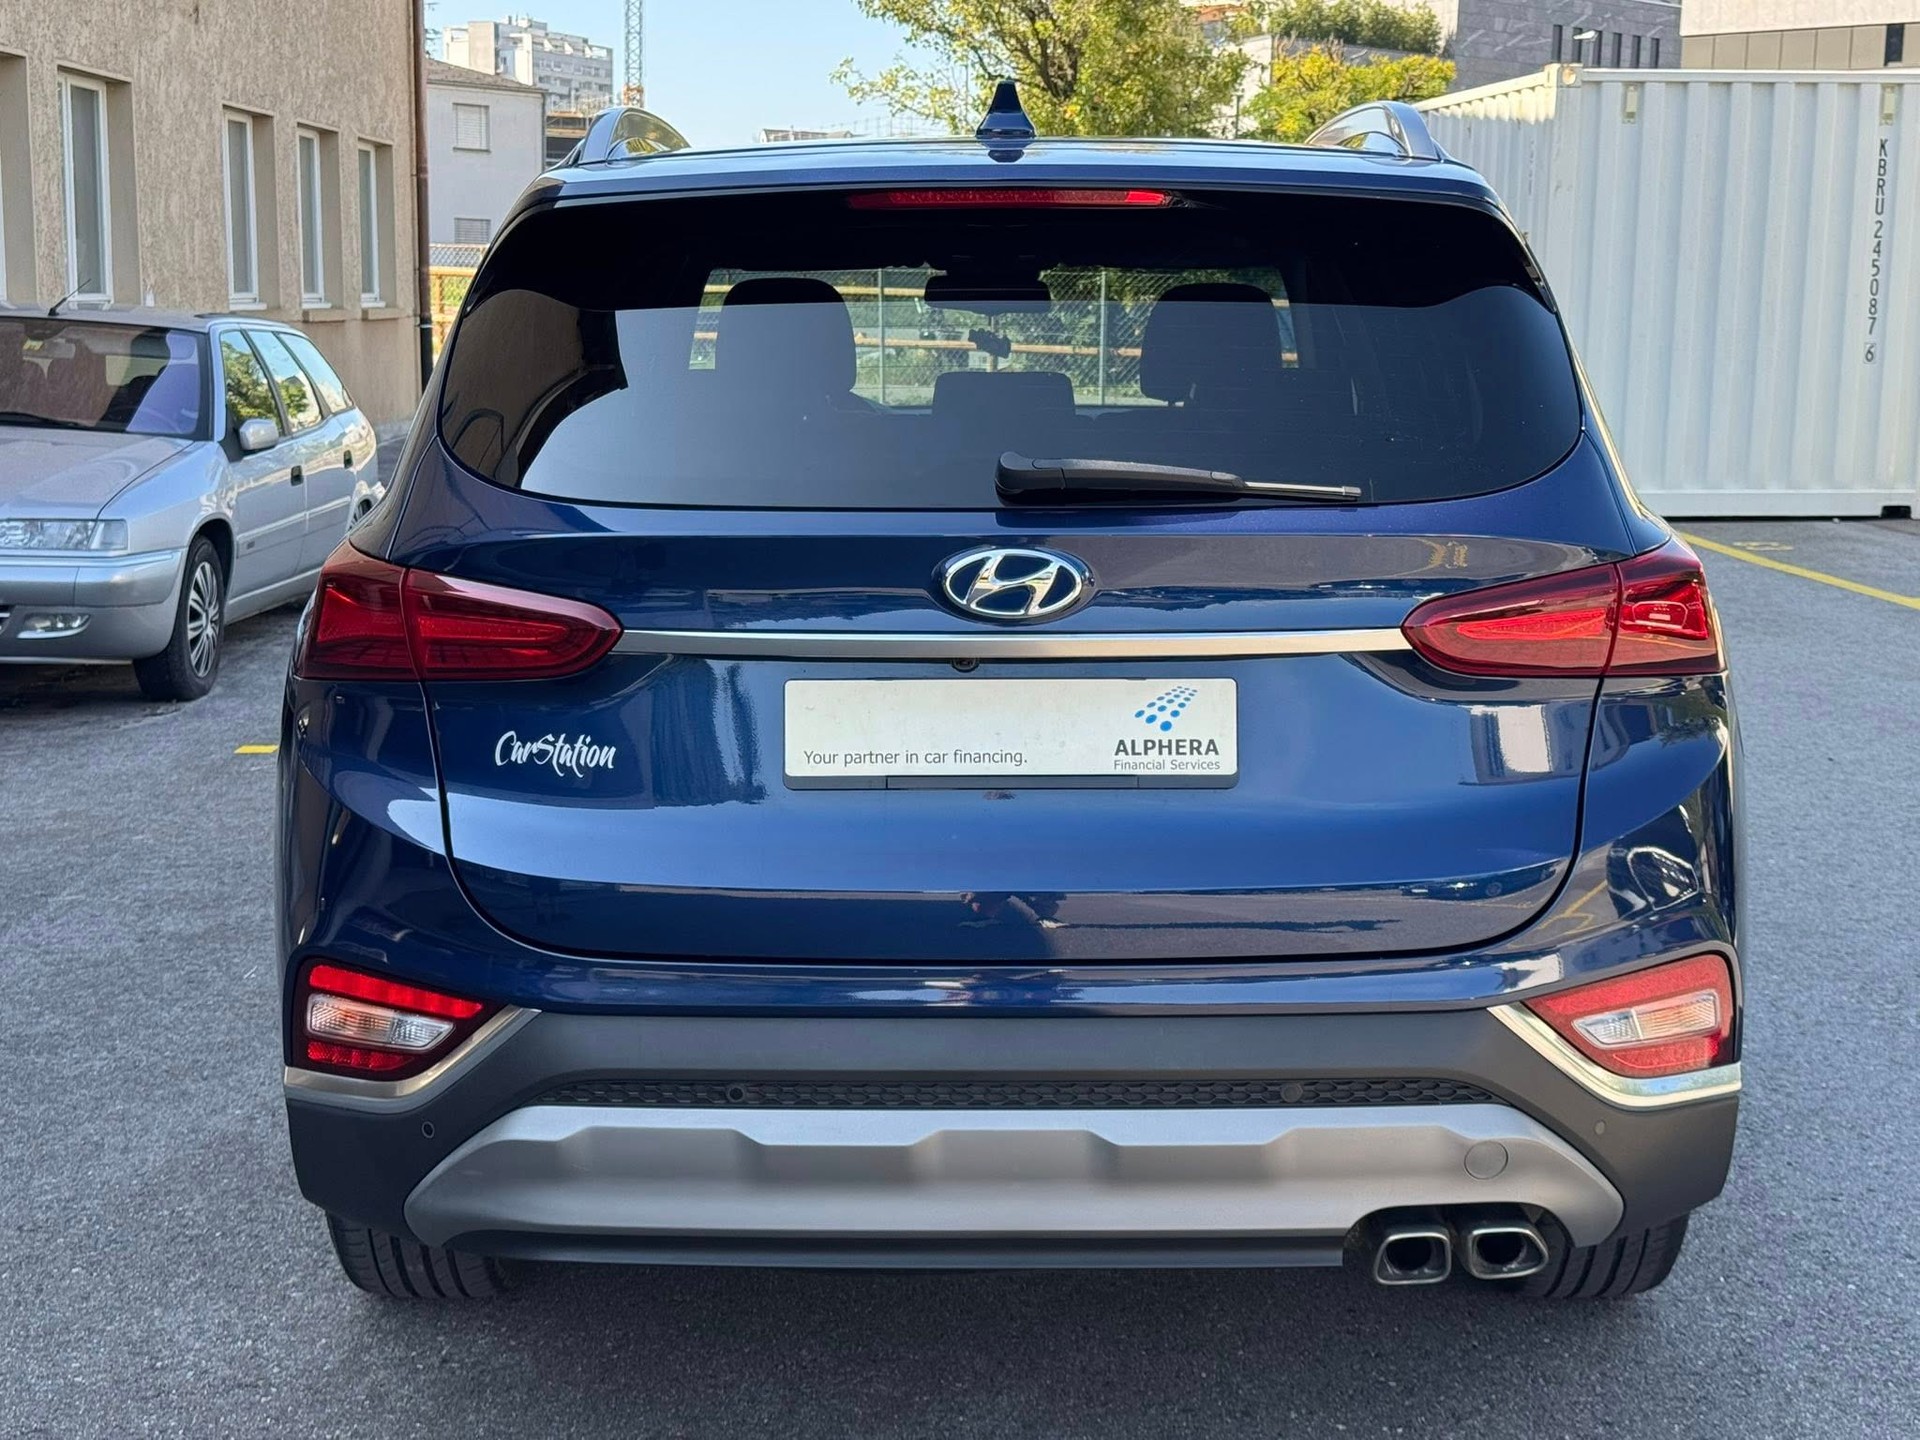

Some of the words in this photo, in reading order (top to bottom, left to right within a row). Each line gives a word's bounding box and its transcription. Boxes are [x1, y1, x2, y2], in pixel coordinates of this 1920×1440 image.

[1875, 138, 1889, 216] KBRU
[1868, 220, 1884, 335] 245087
[495, 730, 617, 778] CarStation
[803, 750, 839, 765] Your
[844, 750, 900, 768] partner
[905, 749, 919, 764] in
[924, 752, 949, 764] car
[954, 749, 1028, 767] financing.
[1114, 738, 1219, 756] ALPHERA
[1113, 759, 1165, 770] Financial
[1170, 759, 1220, 770] Services
